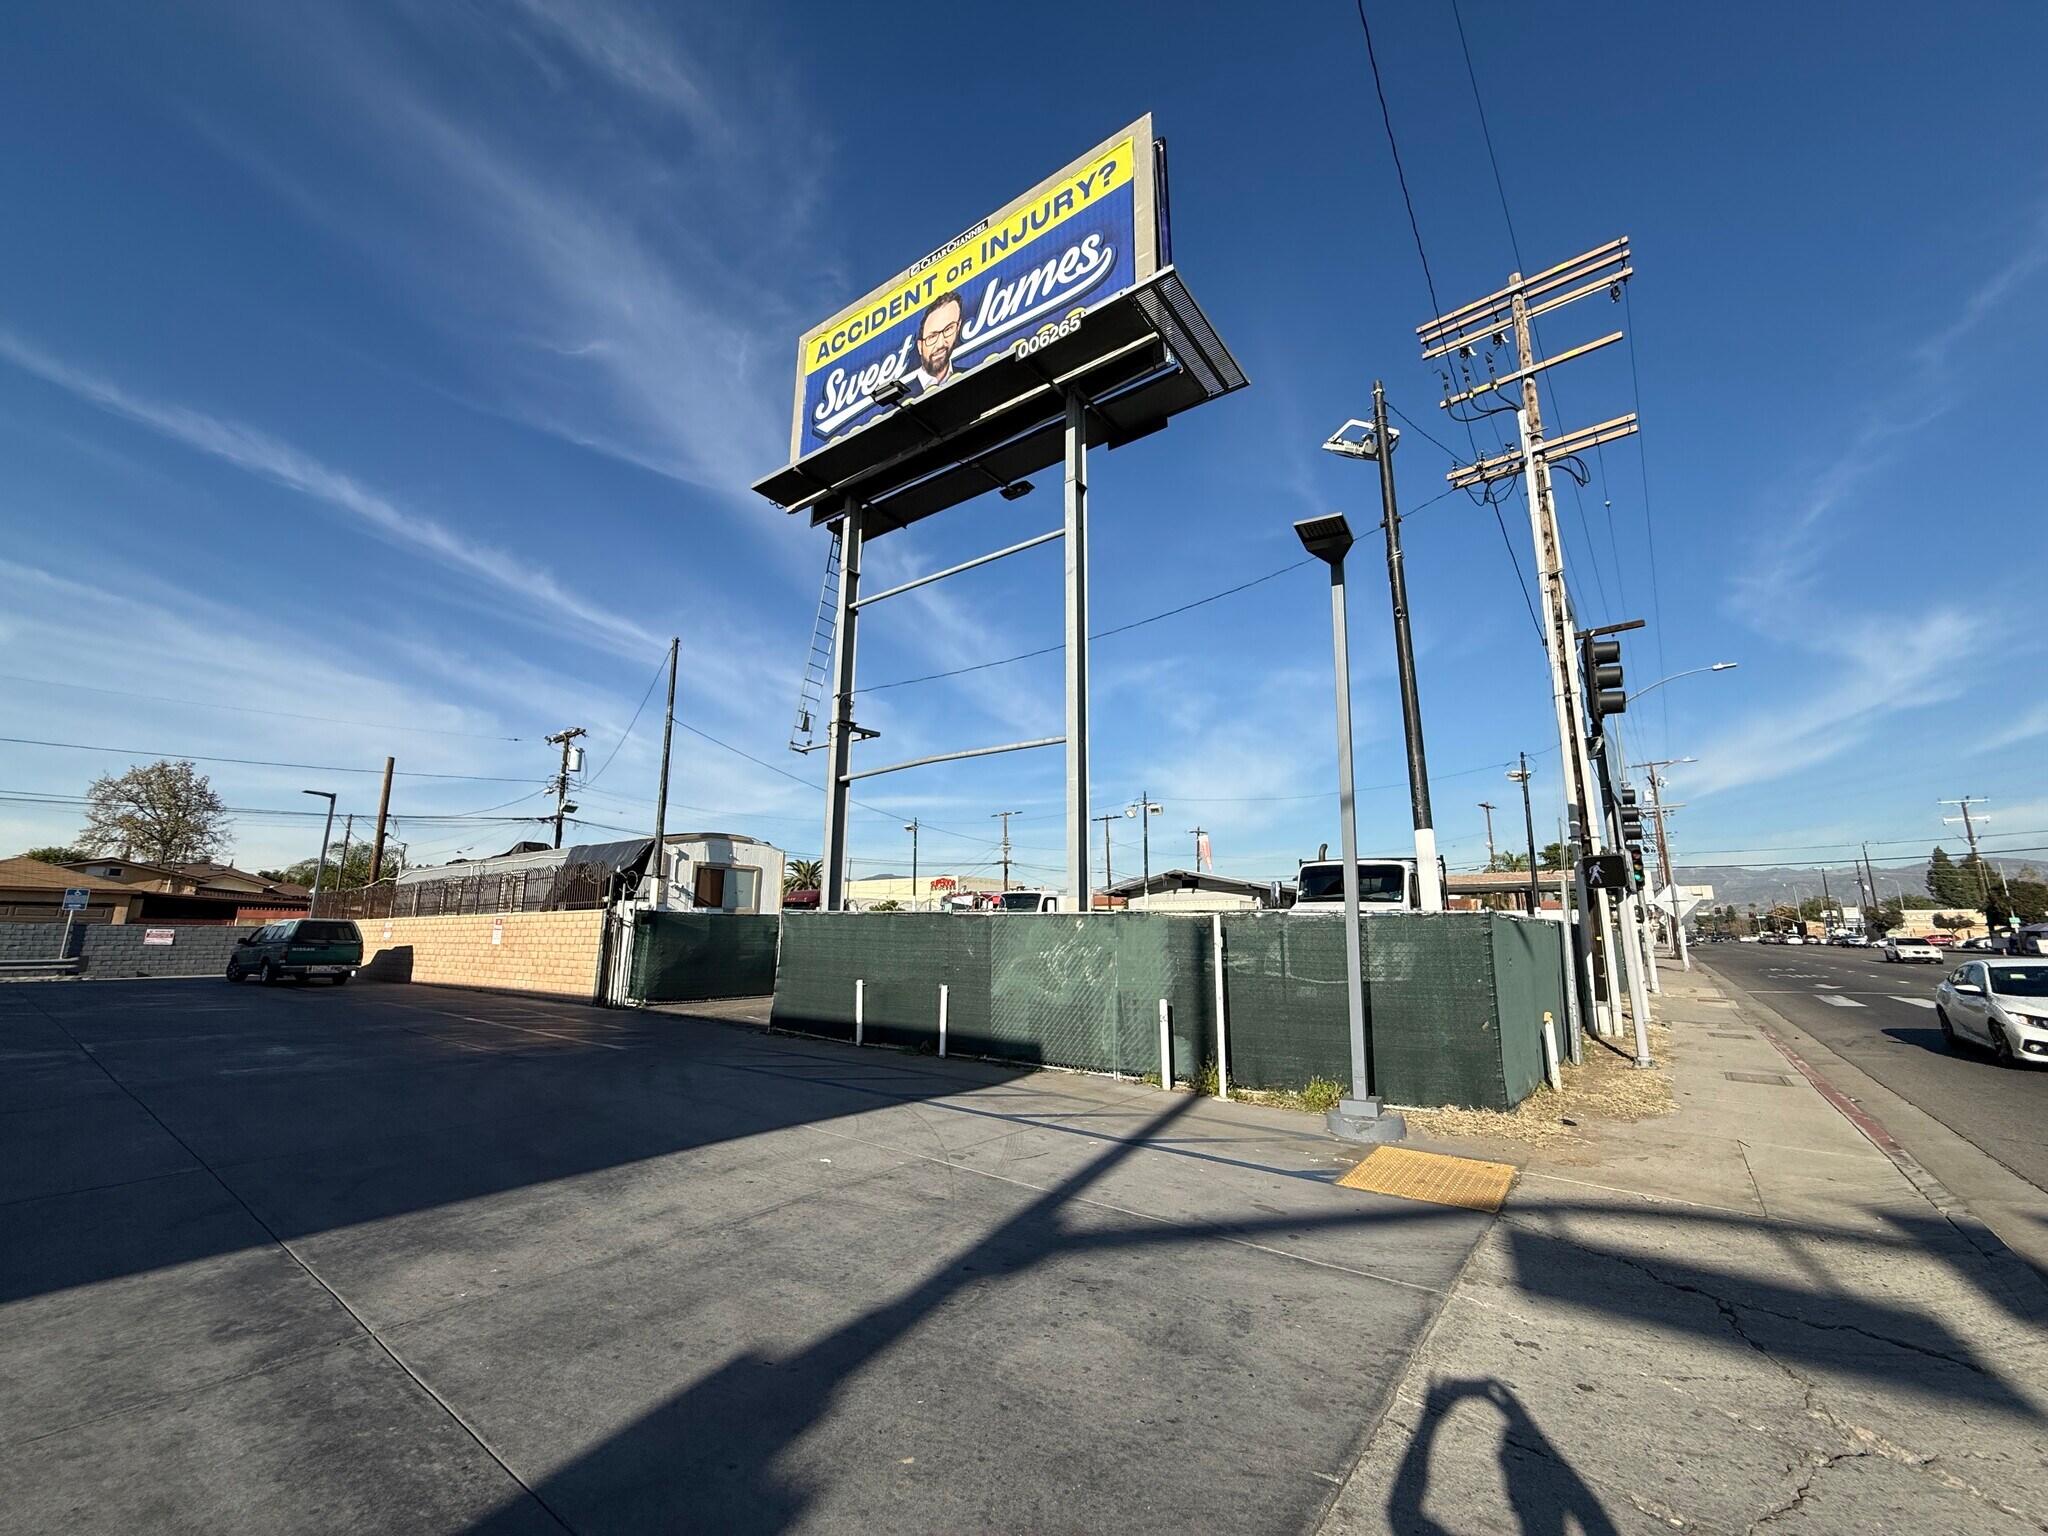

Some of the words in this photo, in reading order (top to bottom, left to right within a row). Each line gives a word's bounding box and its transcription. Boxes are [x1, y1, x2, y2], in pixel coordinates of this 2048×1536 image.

[815, 334, 914, 420] Sweet
[961, 233, 1102, 340] James
[816, 273, 938, 364] ACCIDENT
[947, 256, 973, 284] OR
[981, 160, 1117, 265] INJURY?
[1017, 313, 1081, 358] 006265
